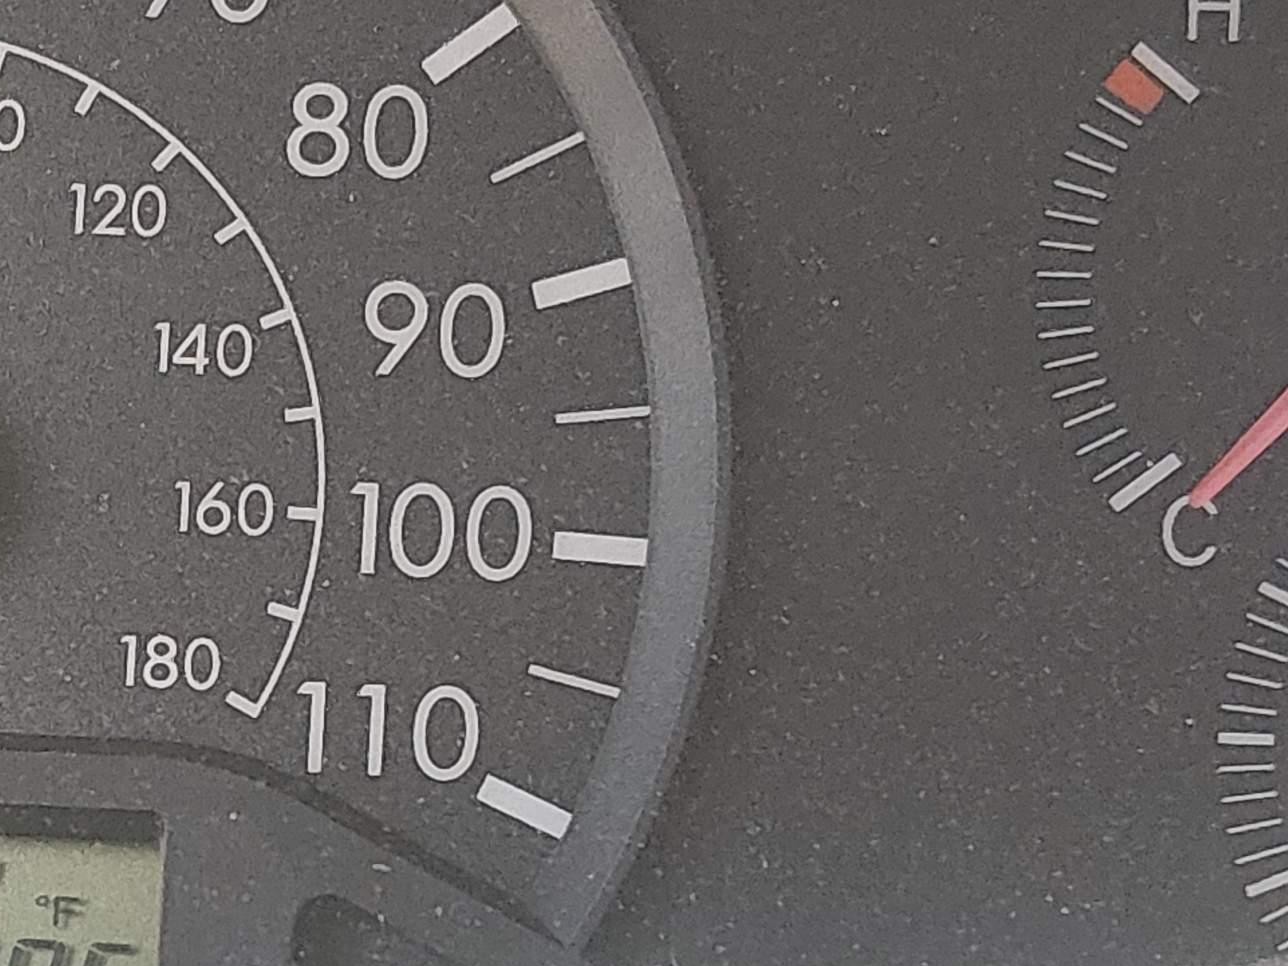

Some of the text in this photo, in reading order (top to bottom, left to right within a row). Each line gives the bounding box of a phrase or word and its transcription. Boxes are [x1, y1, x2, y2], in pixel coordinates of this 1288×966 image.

[285, 82, 429, 180] 80
[69, 182, 167, 238] 120
[154, 322, 254, 377] 140
[364, 279, 506, 378] 90
[174, 480, 275, 537] 160
[348, 481, 532, 582] 100
[1162, 494, 1219, 567] C
[120, 633, 221, 691] 180
[296, 681, 480, 782] 110
